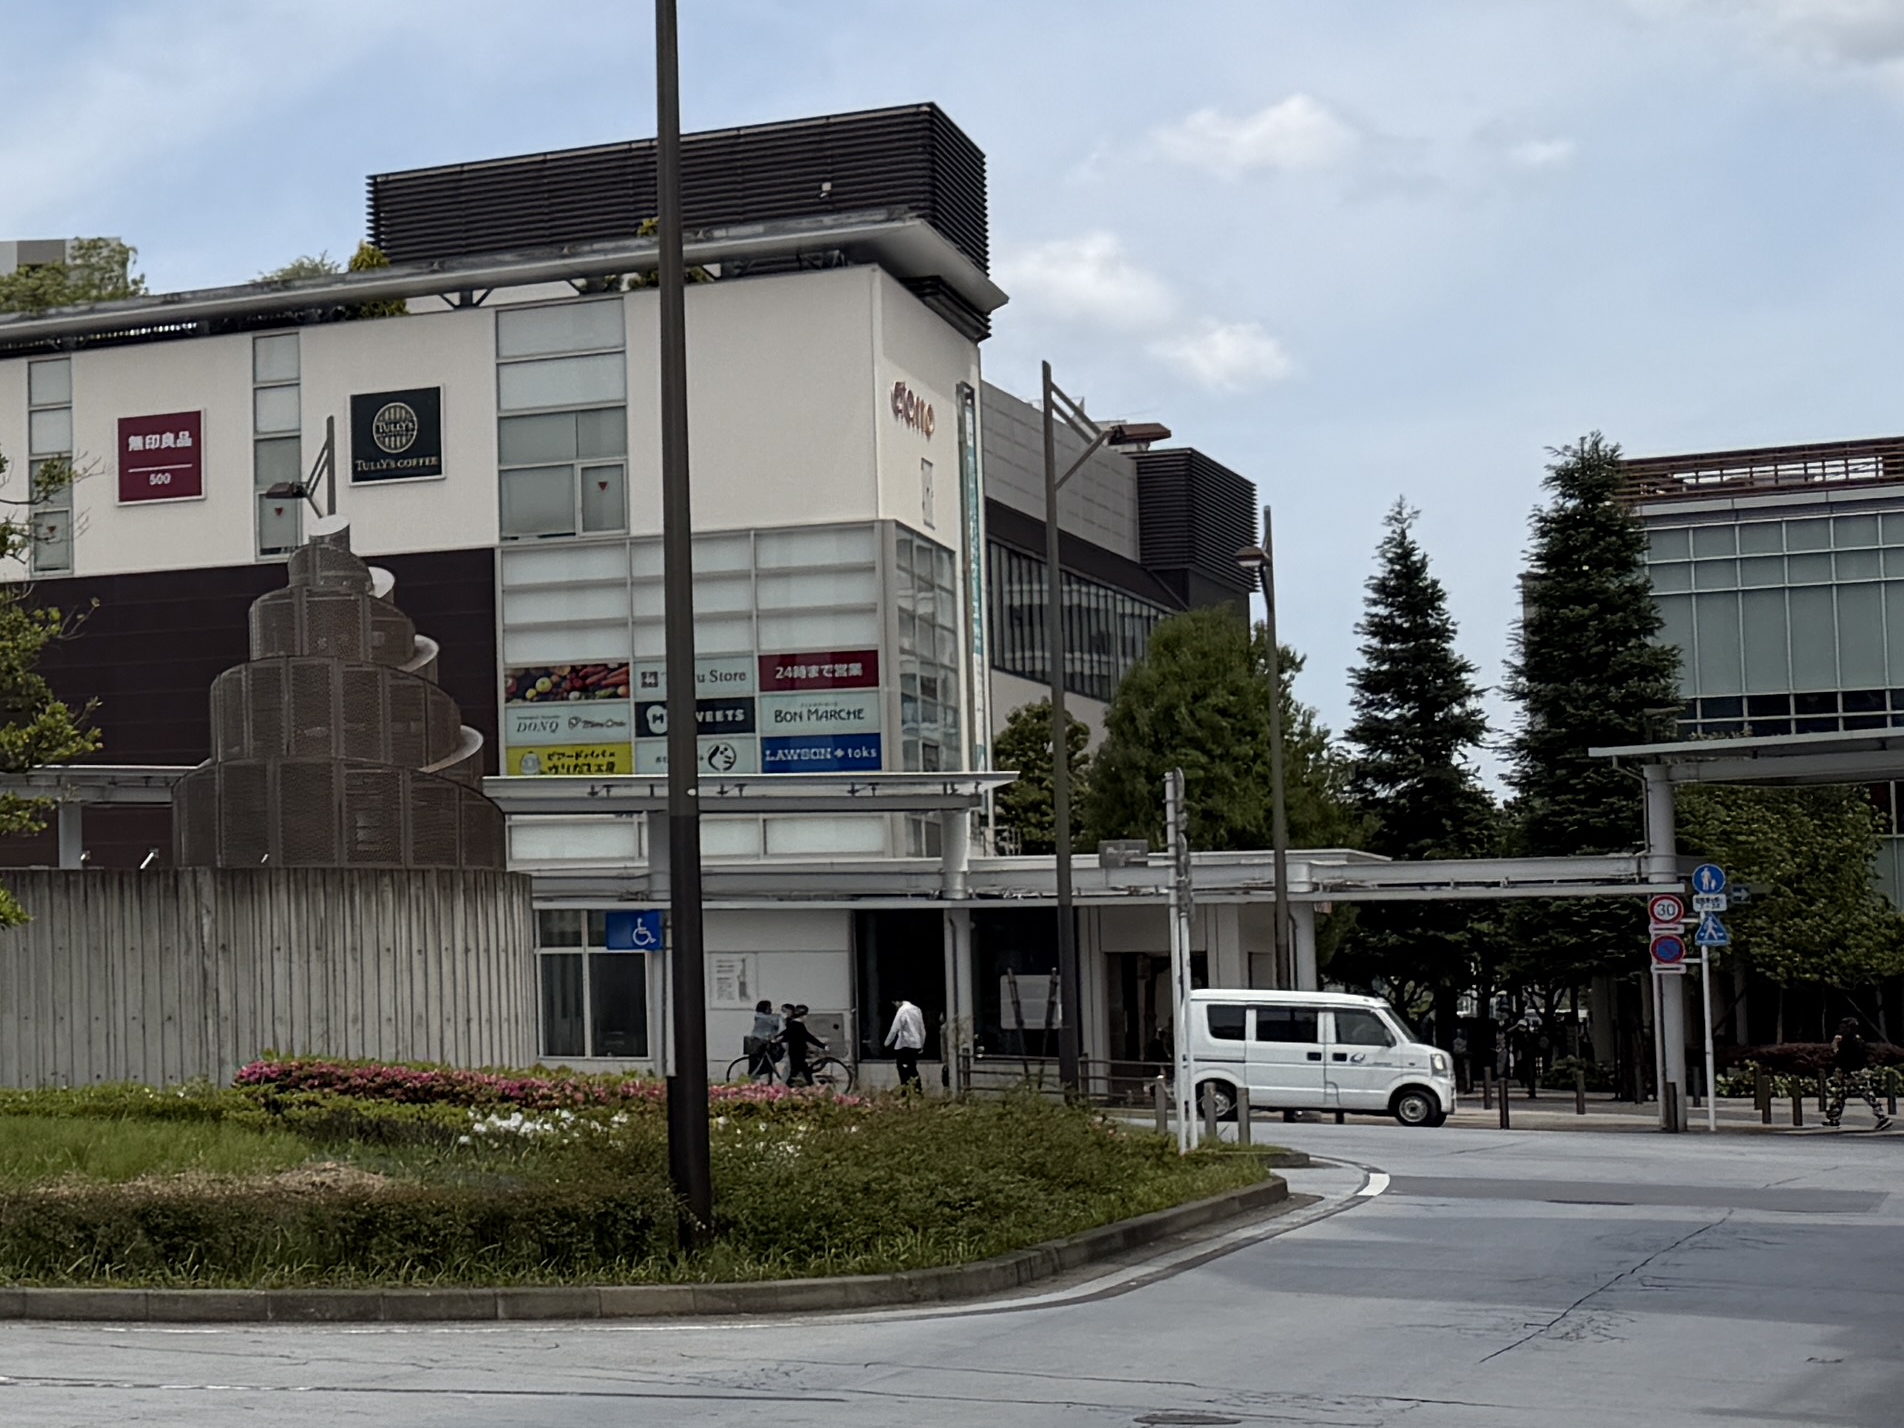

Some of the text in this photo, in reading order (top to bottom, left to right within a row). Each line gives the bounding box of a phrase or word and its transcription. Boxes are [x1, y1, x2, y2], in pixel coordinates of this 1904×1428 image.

[128, 431, 192, 452] 無印良品
[149, 473, 171, 486] 500
[709, 669, 747, 684] Store
[765, 747, 832, 761] LAWSON
[1656, 903, 1677, 916] 30
